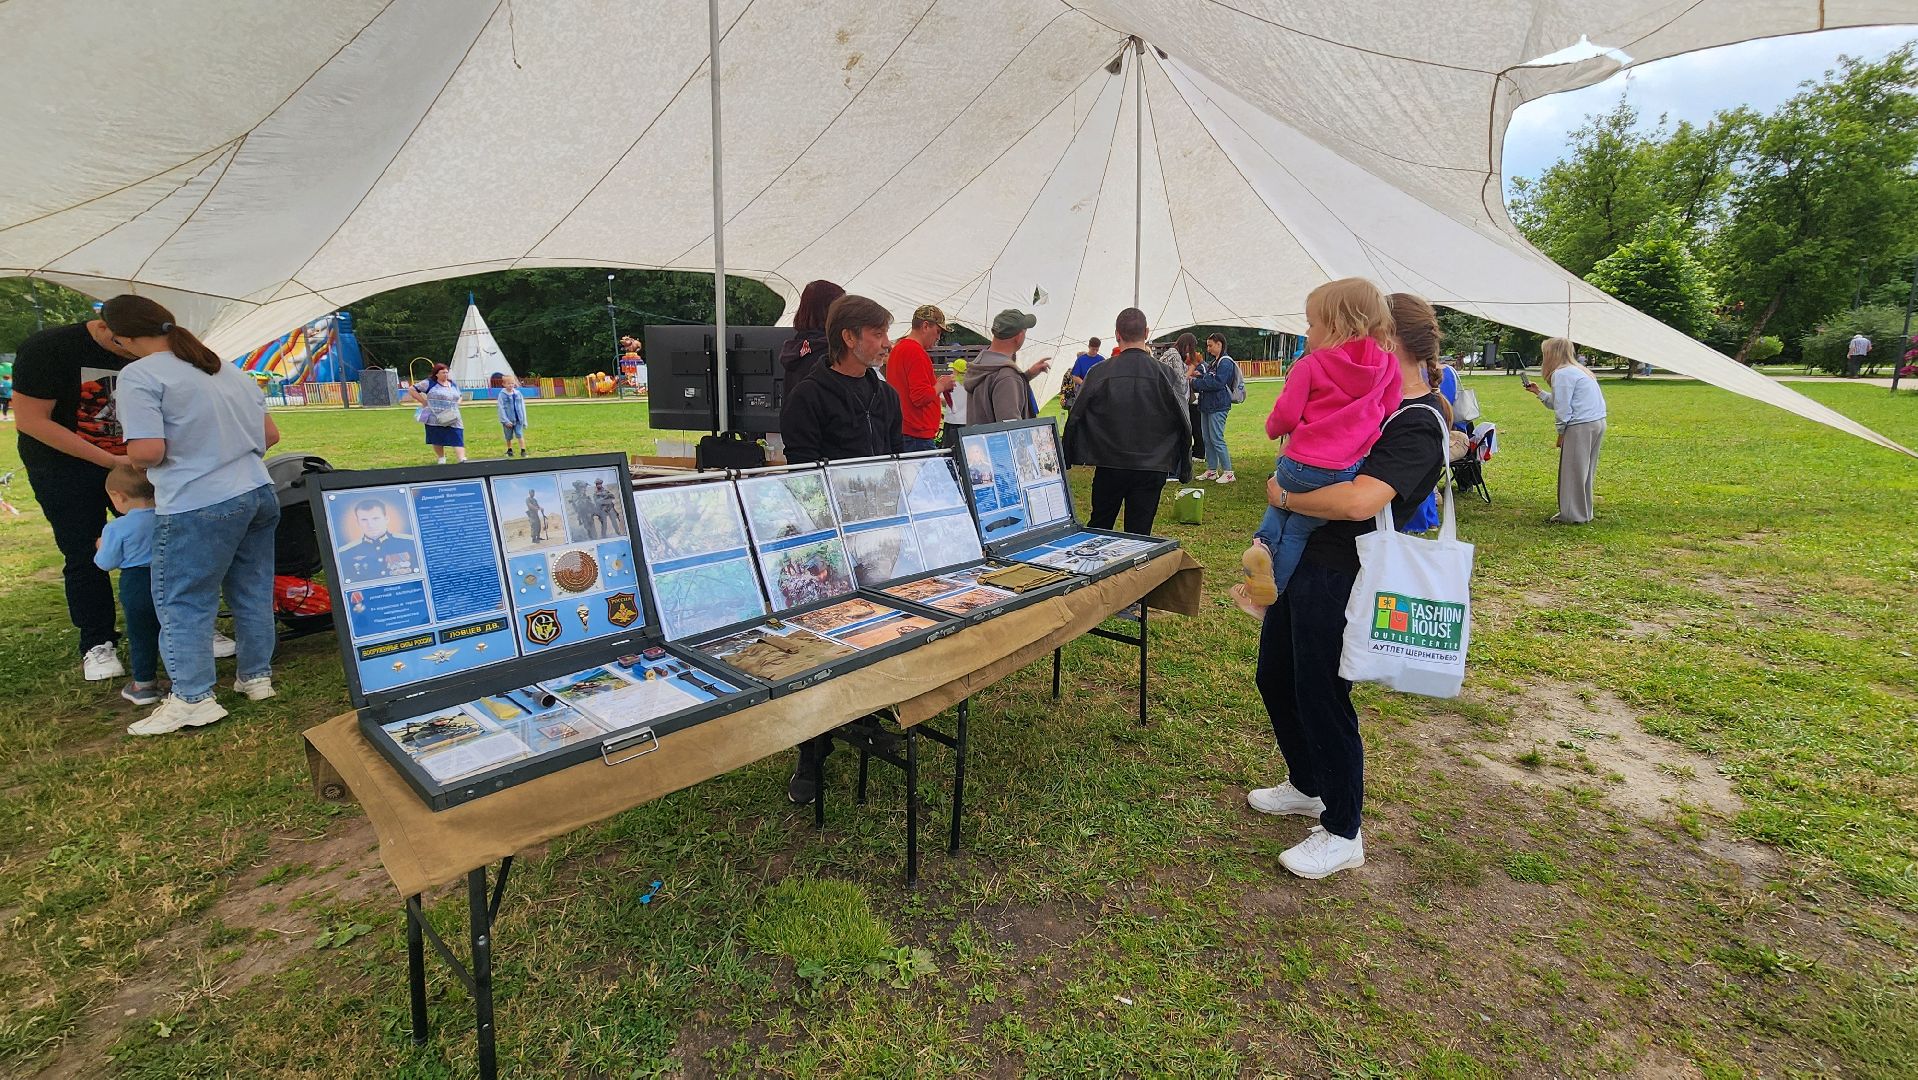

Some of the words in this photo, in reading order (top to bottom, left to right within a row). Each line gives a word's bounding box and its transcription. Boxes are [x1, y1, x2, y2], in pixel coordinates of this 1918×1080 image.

[1411, 602, 1462, 624] FASHION
[449, 626, 482, 639] ЛОВЦЕВ
[1411, 618, 1452, 639] HOUSE
[399, 640, 414, 649] СИЛЫ
[413, 636, 433, 646] РОССИИ
[1374, 631, 1416, 645] OUTLET
[1372, 643, 1405, 654] АУТЛЕТ
[1405, 648, 1458, 661] ШЕРЕМЕТЬЕВО
